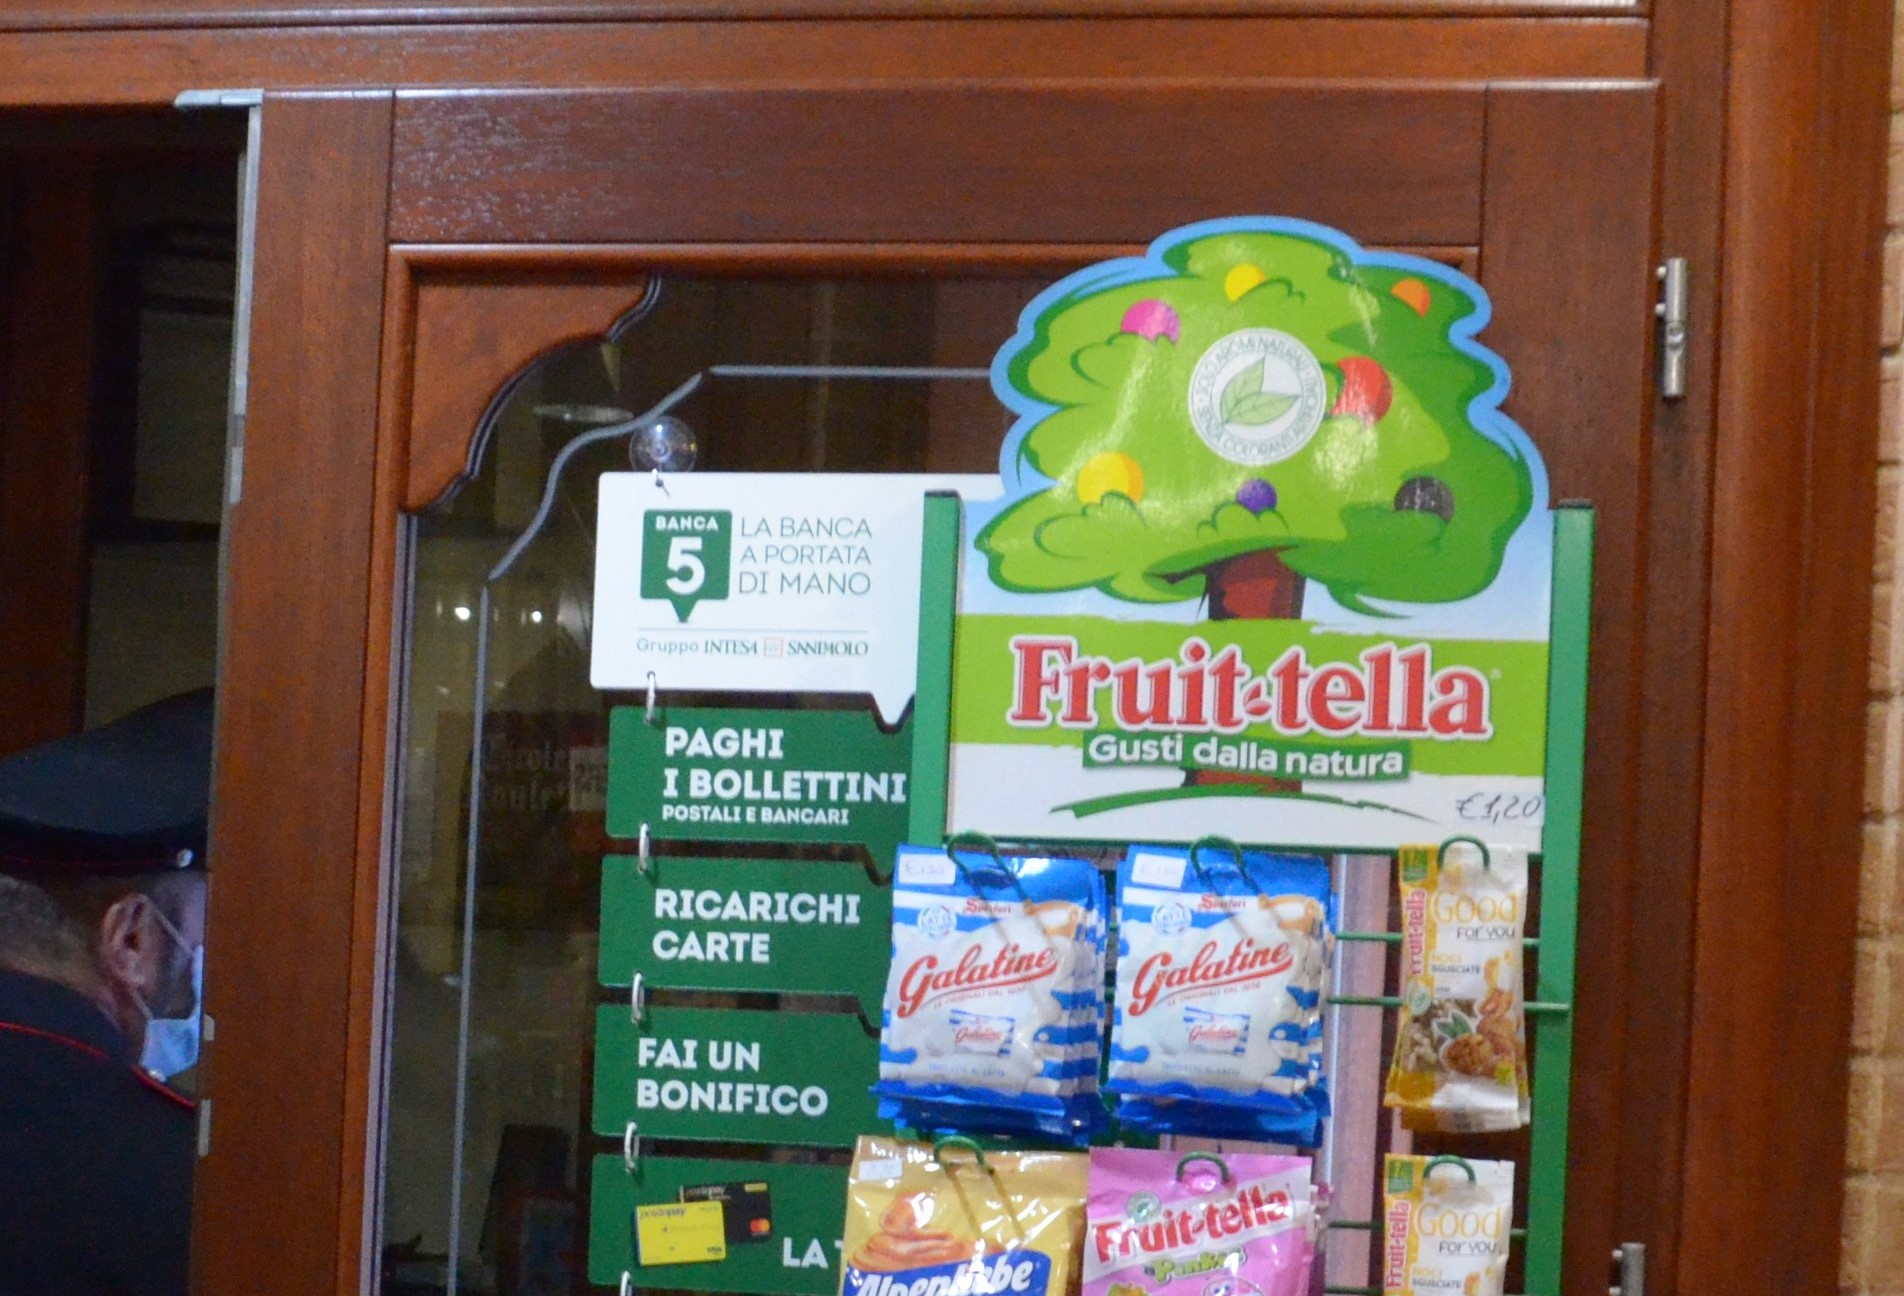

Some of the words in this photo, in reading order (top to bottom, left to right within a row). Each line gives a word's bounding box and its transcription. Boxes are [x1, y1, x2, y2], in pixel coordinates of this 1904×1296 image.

[655, 515, 719, 532] BANCA
[741, 517, 771, 538] LA
[780, 518, 872, 539] BANCA
[665, 536, 705, 595] 5
[740, 546, 757, 563] A
[765, 545, 872, 565] PORTATA
[739, 571, 769, 594] DI
[780, 571, 871, 595] MANO
[636, 637, 699, 656] Gruppo
[704, 639, 758, 655] INTESA
[1009, 637, 1491, 738] Fruit-tella
[664, 726, 785, 759] PAGHI
[1089, 734, 1183, 763] Gusti
[1193, 737, 1278, 771] dalla
[1285, 750, 1404, 777] natura
[663, 768, 679, 797] I
[690, 768, 907, 803] BOLLETTINI
[662, 805, 741, 823] POSTALI
[747, 807, 756, 823] E
[761, 807, 850, 825] BANCARI
[654, 888, 861, 924] RICARICHI
[652, 930, 771, 963] CARTE
[897, 944, 1058, 1018] Galatine
[1128, 940, 1294, 1017] Galatine
[638, 1037, 697, 1069] FAI
[708, 1040, 760, 1072] UN
[636, 1078, 829, 1117] BONIFICO
[1095, 1187, 1290, 1263] Fruit-tella
[782, 1237, 829, 1269] LA
